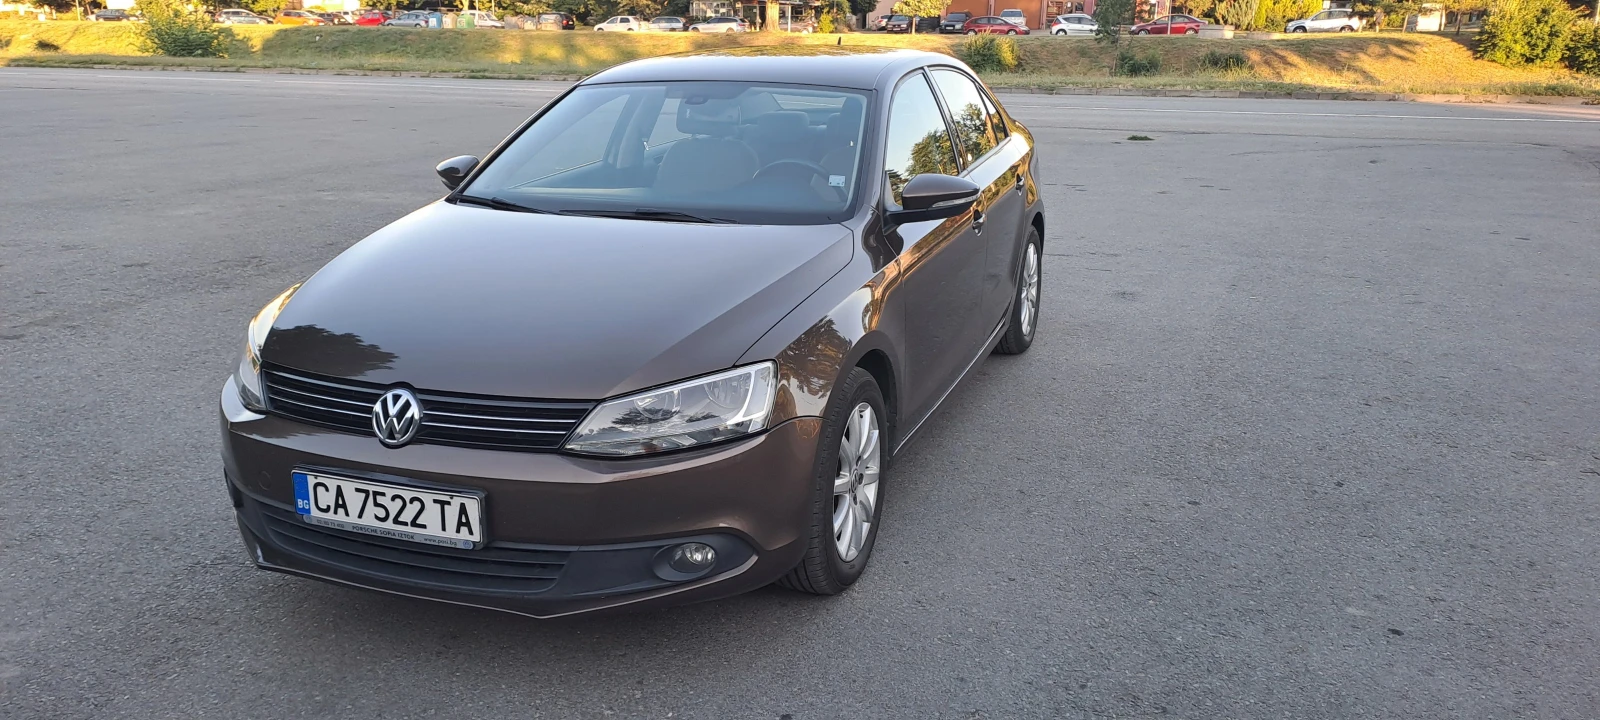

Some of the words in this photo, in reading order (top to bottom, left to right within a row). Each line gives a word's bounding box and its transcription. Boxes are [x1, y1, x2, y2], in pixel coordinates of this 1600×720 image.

[373, 389, 419, 444] VW
[297, 498, 310, 510] BG
[313, 481, 350, 518] CA
[354, 487, 427, 529] 7522
[432, 498, 474, 536] TA
[352, 525, 379, 534] PORSCHE
[379, 529, 397, 537] SOFIA
[397, 532, 415, 540] IZTOK
